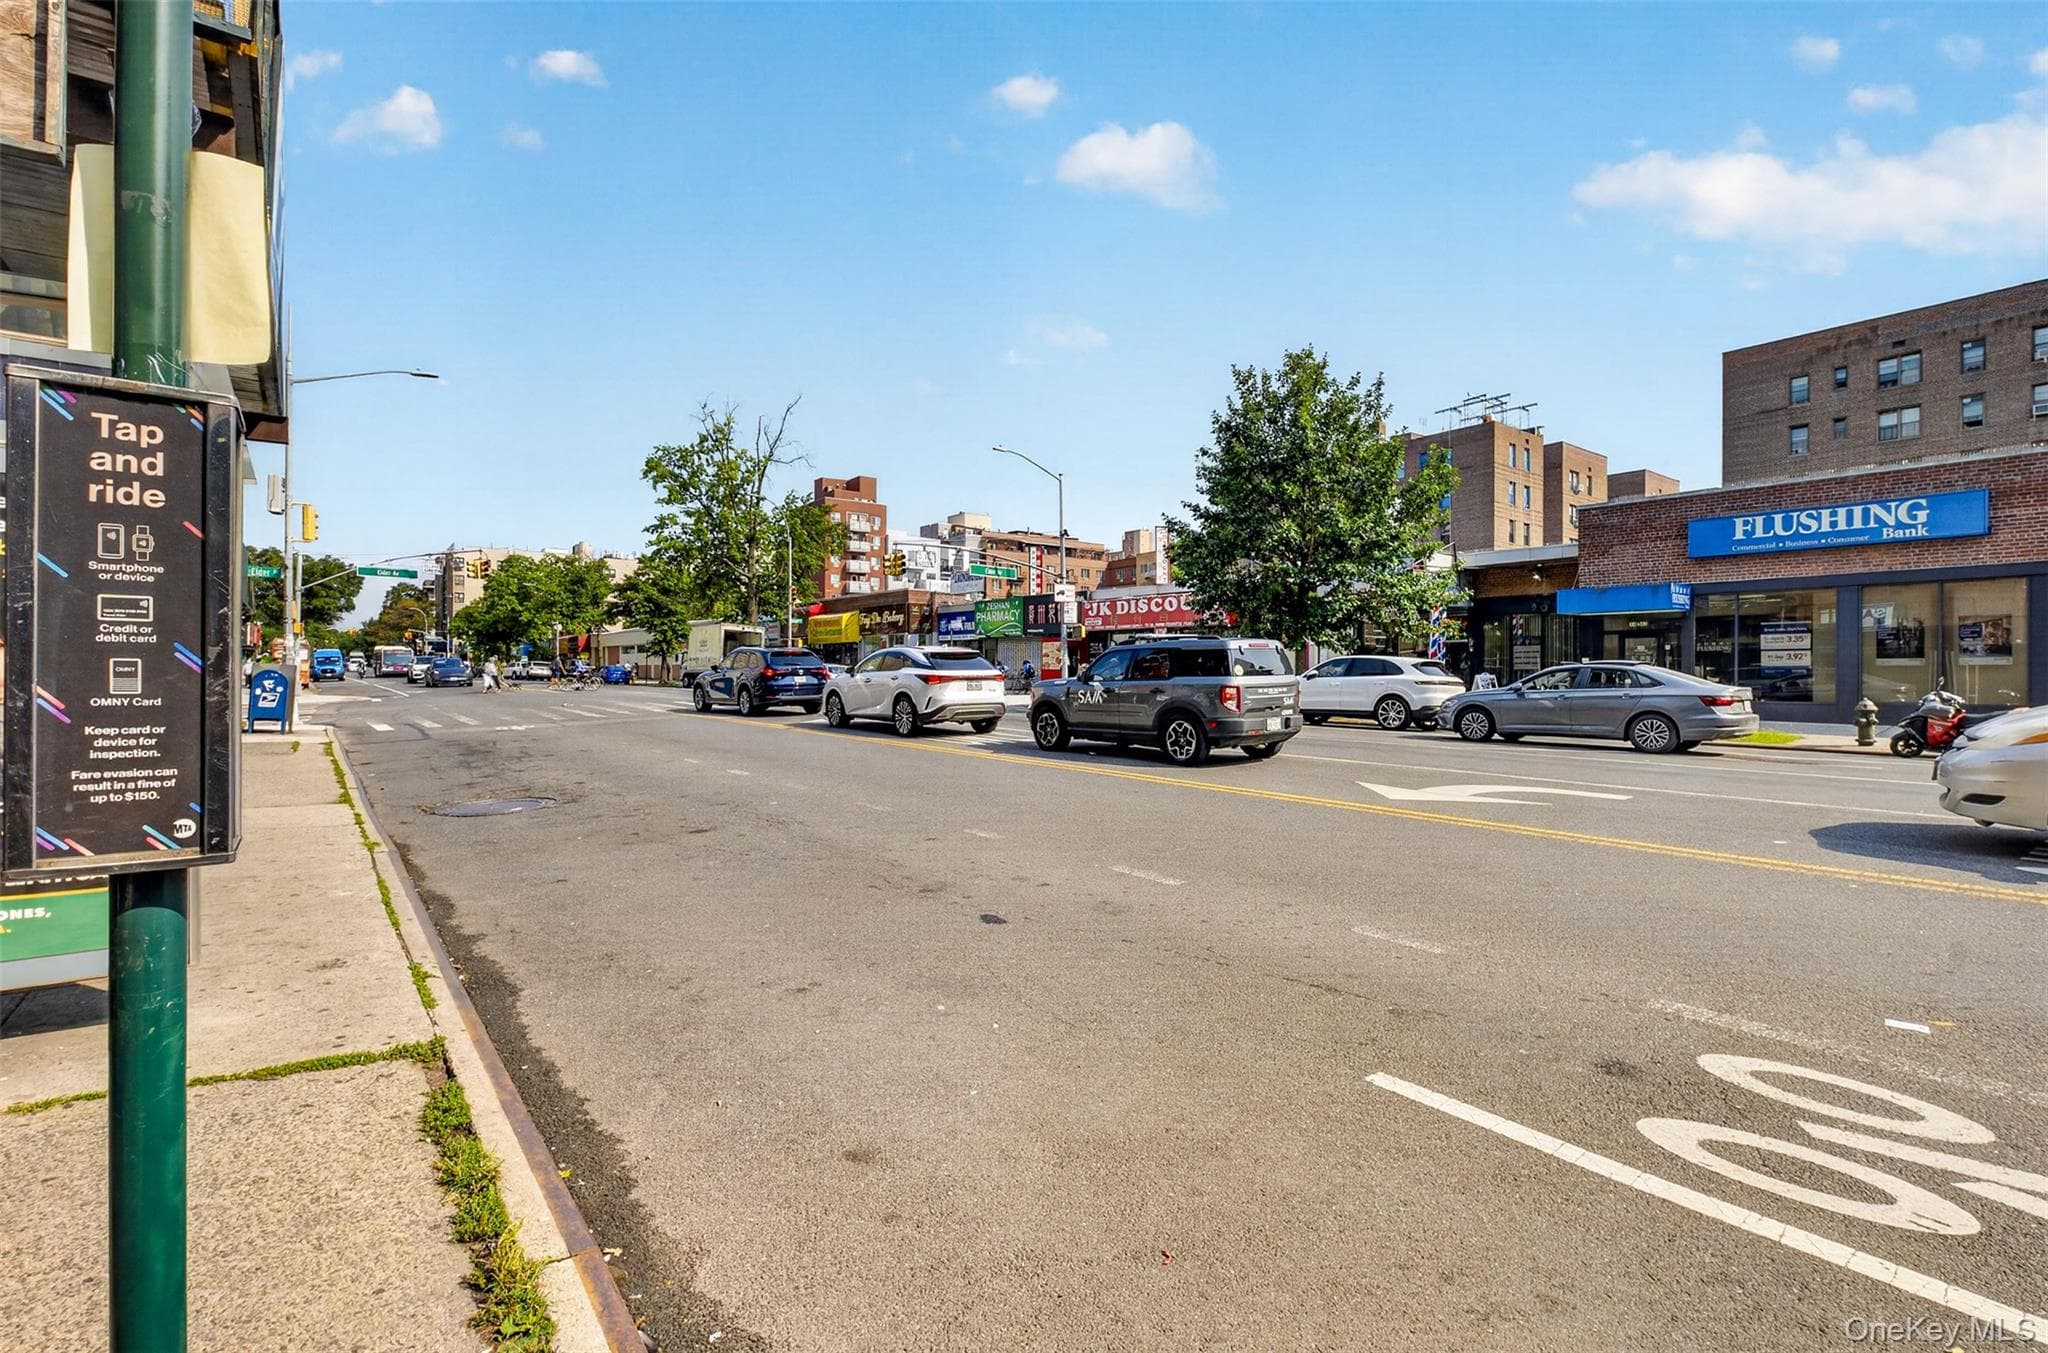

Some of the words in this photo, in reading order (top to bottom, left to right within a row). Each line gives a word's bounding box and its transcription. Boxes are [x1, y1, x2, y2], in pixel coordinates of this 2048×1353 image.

[90, 412, 164, 448] Tap
[89, 451, 164, 476] and
[88, 479, 166, 508] ride
[1732, 499, 1930, 540] FLUSHING
[1882, 524, 1929, 540] Bank
[1732, 542, 1776, 552] Commercial
[1785, 539, 1818, 548] Business
[1827, 535, 1870, 544] Consumer
[88, 560, 165, 573] Smartphone
[114, 572, 155, 582] device
[986, 601, 1010, 610] ZESHAN
[1088, 602, 1112, 616] JK
[1116, 594, 1192, 615] DISCOU
[881, 610, 904, 626] Bakery
[976, 609, 1020, 622] PHARMACY
[99, 623, 137, 633] Credit
[95, 633, 129, 642] debit
[129, 634, 157, 643] card
[90, 698, 130, 706] OMNY
[132, 697, 161, 706] Card
[84, 726, 119, 736] Keep
[120, 725, 150, 734] card
[152, 726, 166, 734] or
[93, 737, 137, 747] device
[138, 737, 157, 745] for
[89, 749, 161, 760] inspection.
[71, 770, 101, 780] Fare
[103, 768, 153, 778] evasion
[154, 767, 178, 777] can
[73, 781, 112, 792] result
[113, 781, 126, 790] in
[137, 779, 162, 789] fine
[163, 778, 177, 787] of
[90, 794, 108, 804] up
[109, 793, 123, 802] to
[124, 791, 160, 801] $150.
